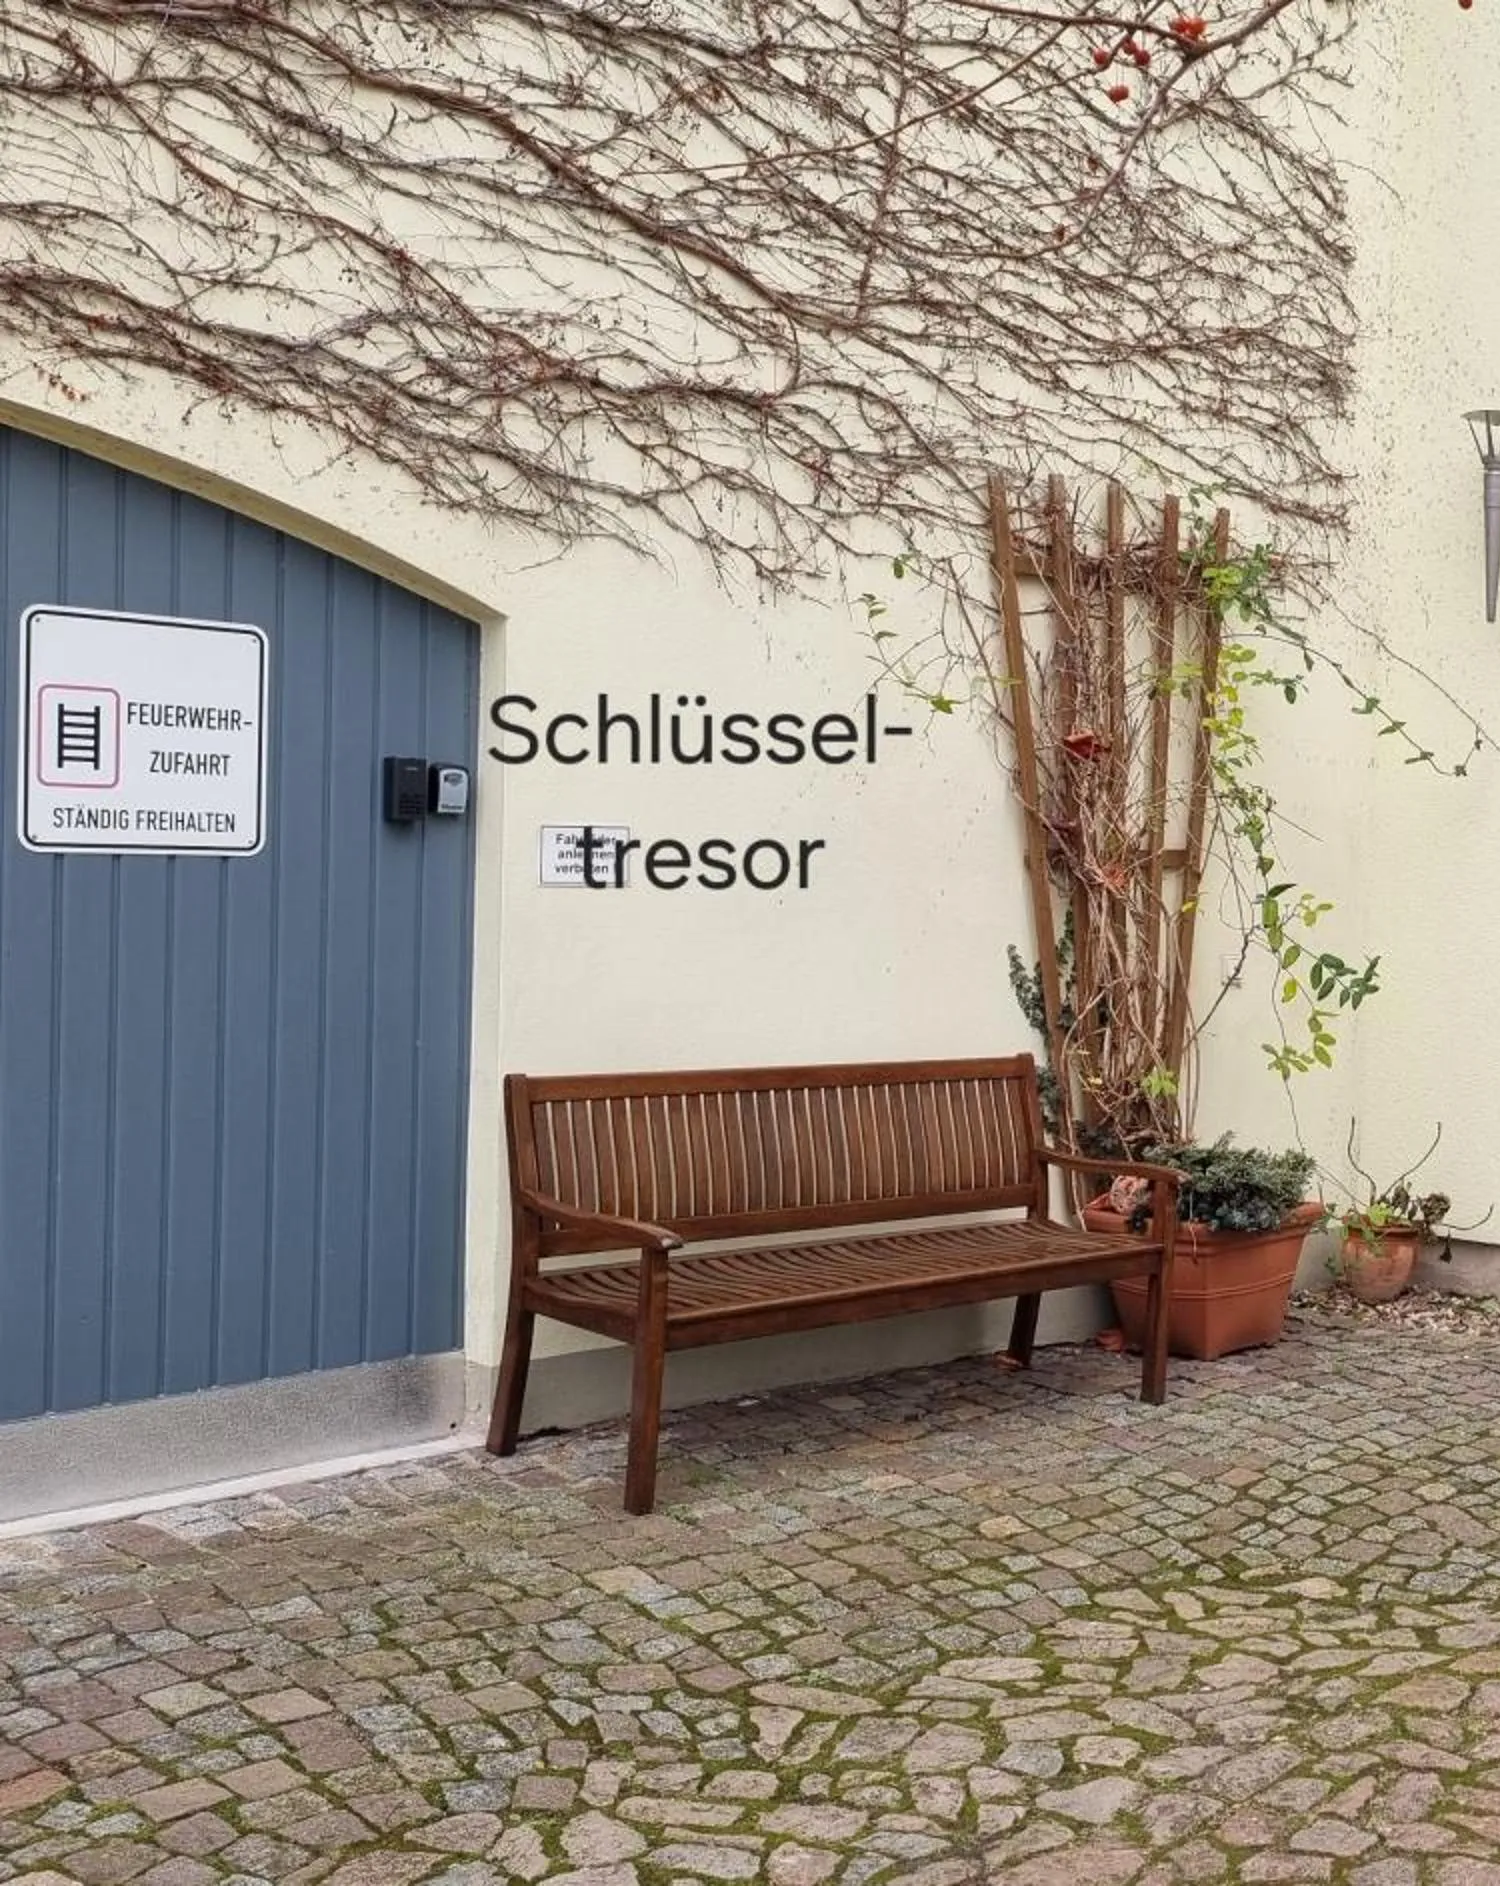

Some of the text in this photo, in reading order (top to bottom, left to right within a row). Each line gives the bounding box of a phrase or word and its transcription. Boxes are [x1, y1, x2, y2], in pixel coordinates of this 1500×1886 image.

[127, 701, 253, 731] FEUERWEHR-
[149, 751, 231, 776] ZUFAHRT
[53, 805, 236, 833] STÄNDIG FREIHALTEN
